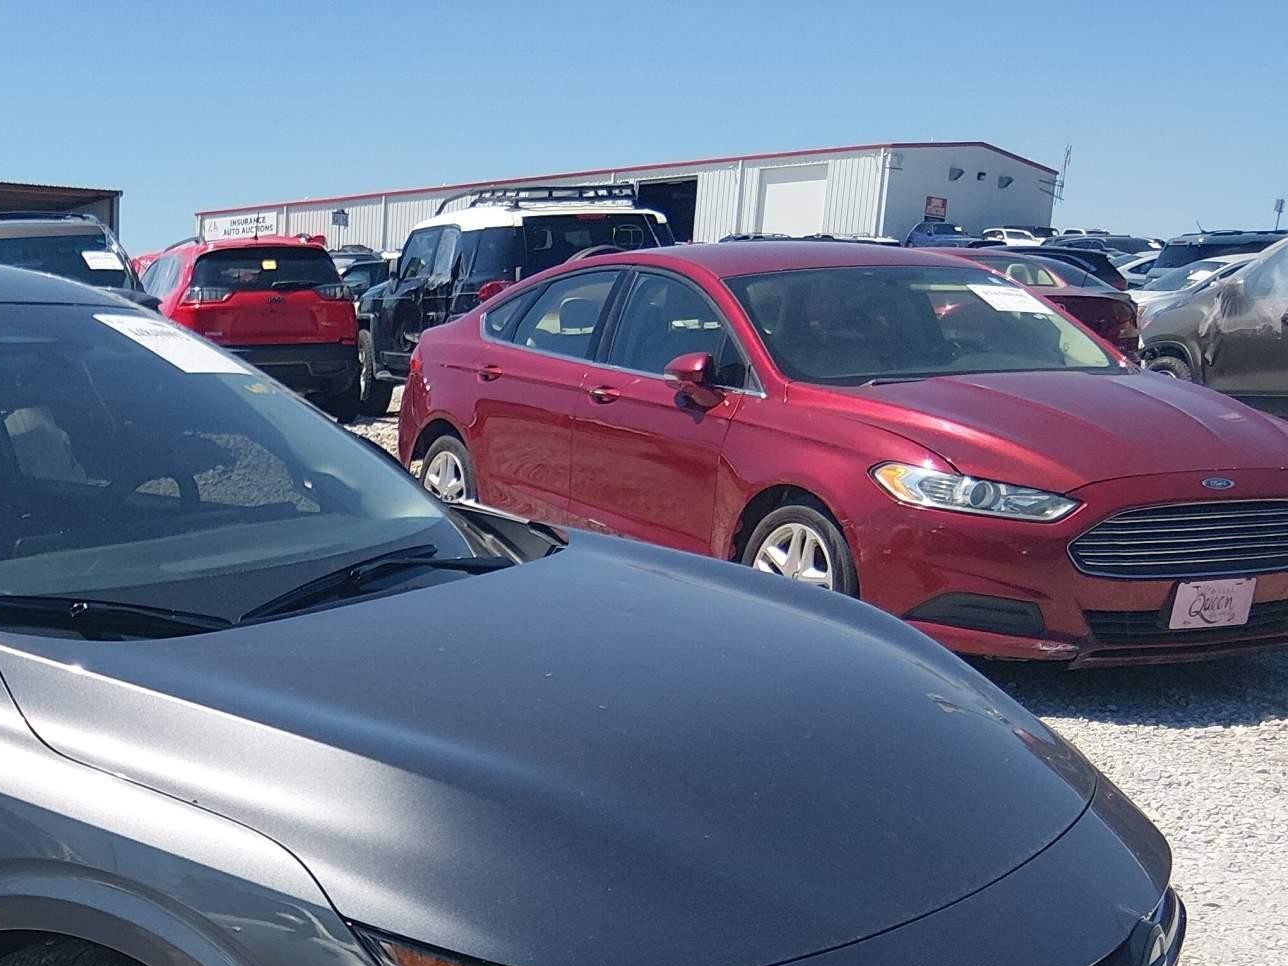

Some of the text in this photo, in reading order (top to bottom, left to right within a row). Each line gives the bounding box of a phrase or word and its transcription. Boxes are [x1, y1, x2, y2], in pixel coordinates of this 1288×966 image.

[230, 216, 265, 226] INSURANCE
[223, 224, 273, 236] AUTO AUCTIONS
[1188, 593, 1233, 624] Queen
